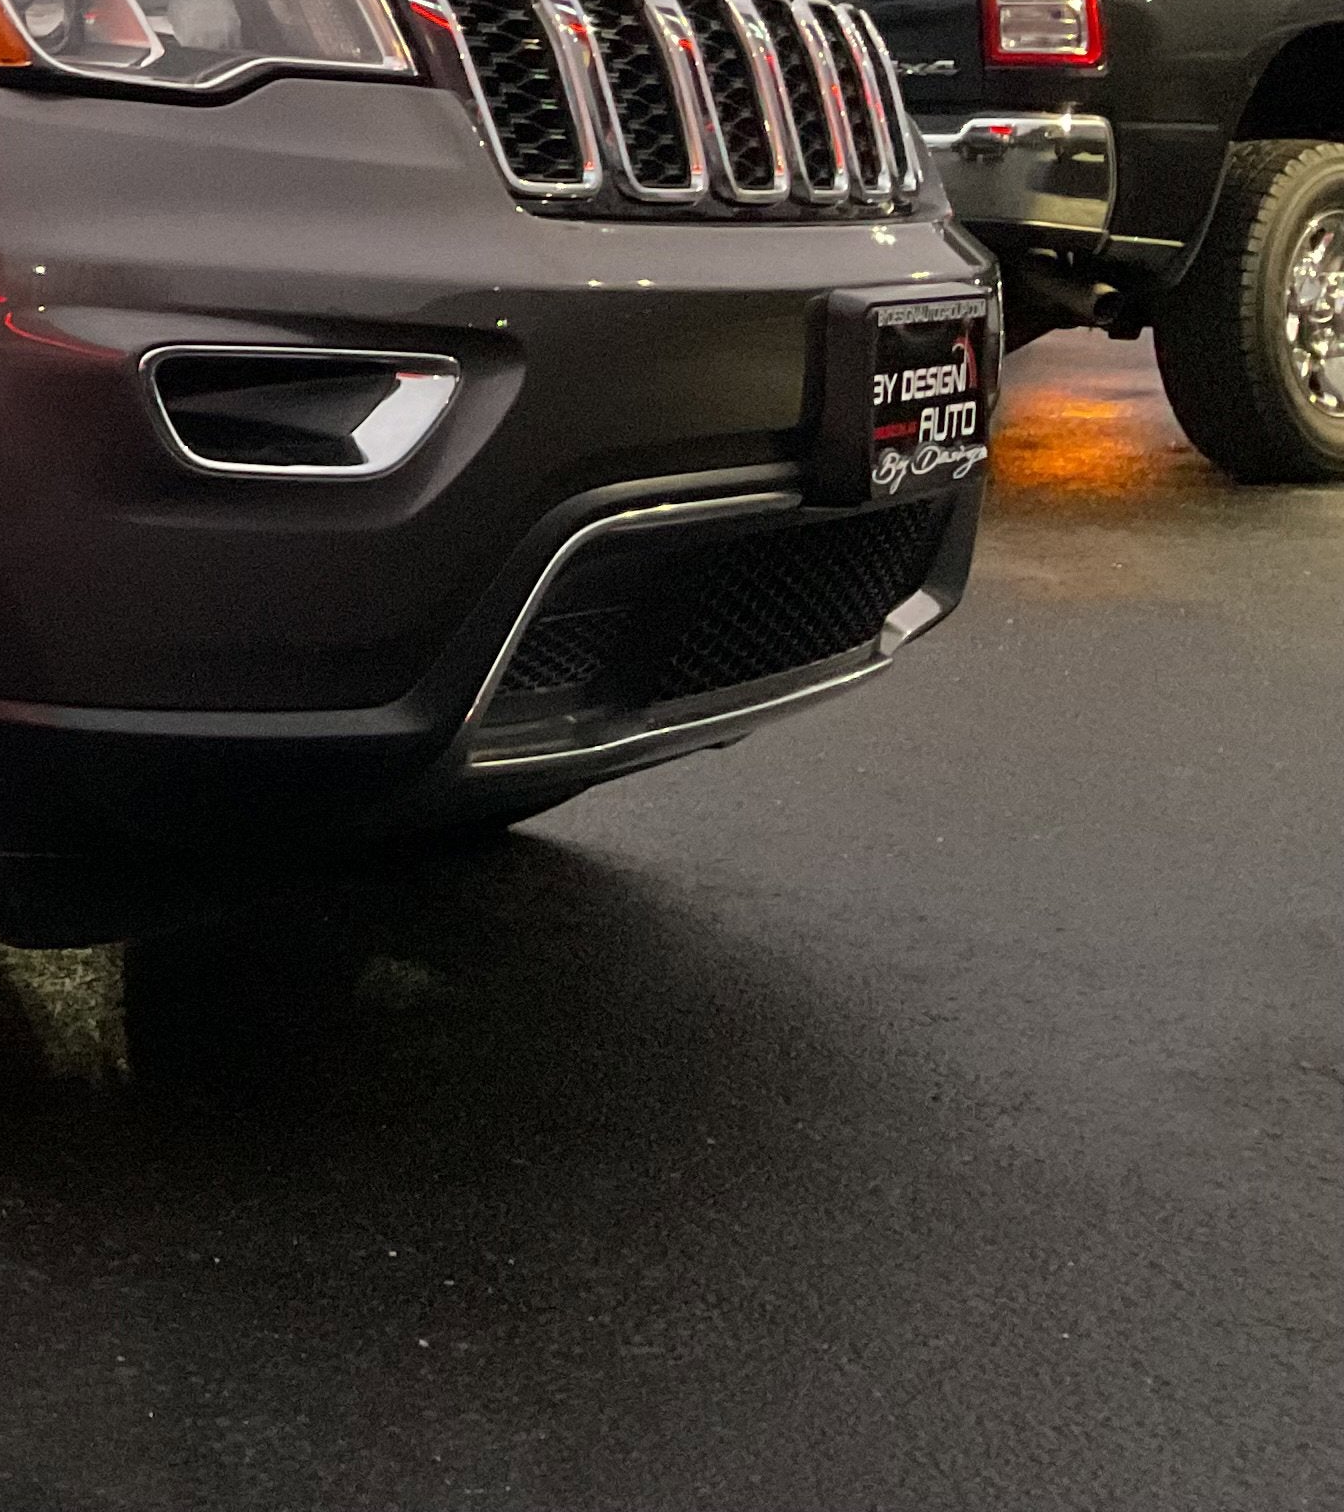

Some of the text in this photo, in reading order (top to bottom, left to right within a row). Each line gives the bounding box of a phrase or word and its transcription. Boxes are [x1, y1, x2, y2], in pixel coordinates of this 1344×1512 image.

[901, 363, 968, 402] DESIGN
[919, 401, 977, 443] AUTO
[872, 452, 910, 495] By
